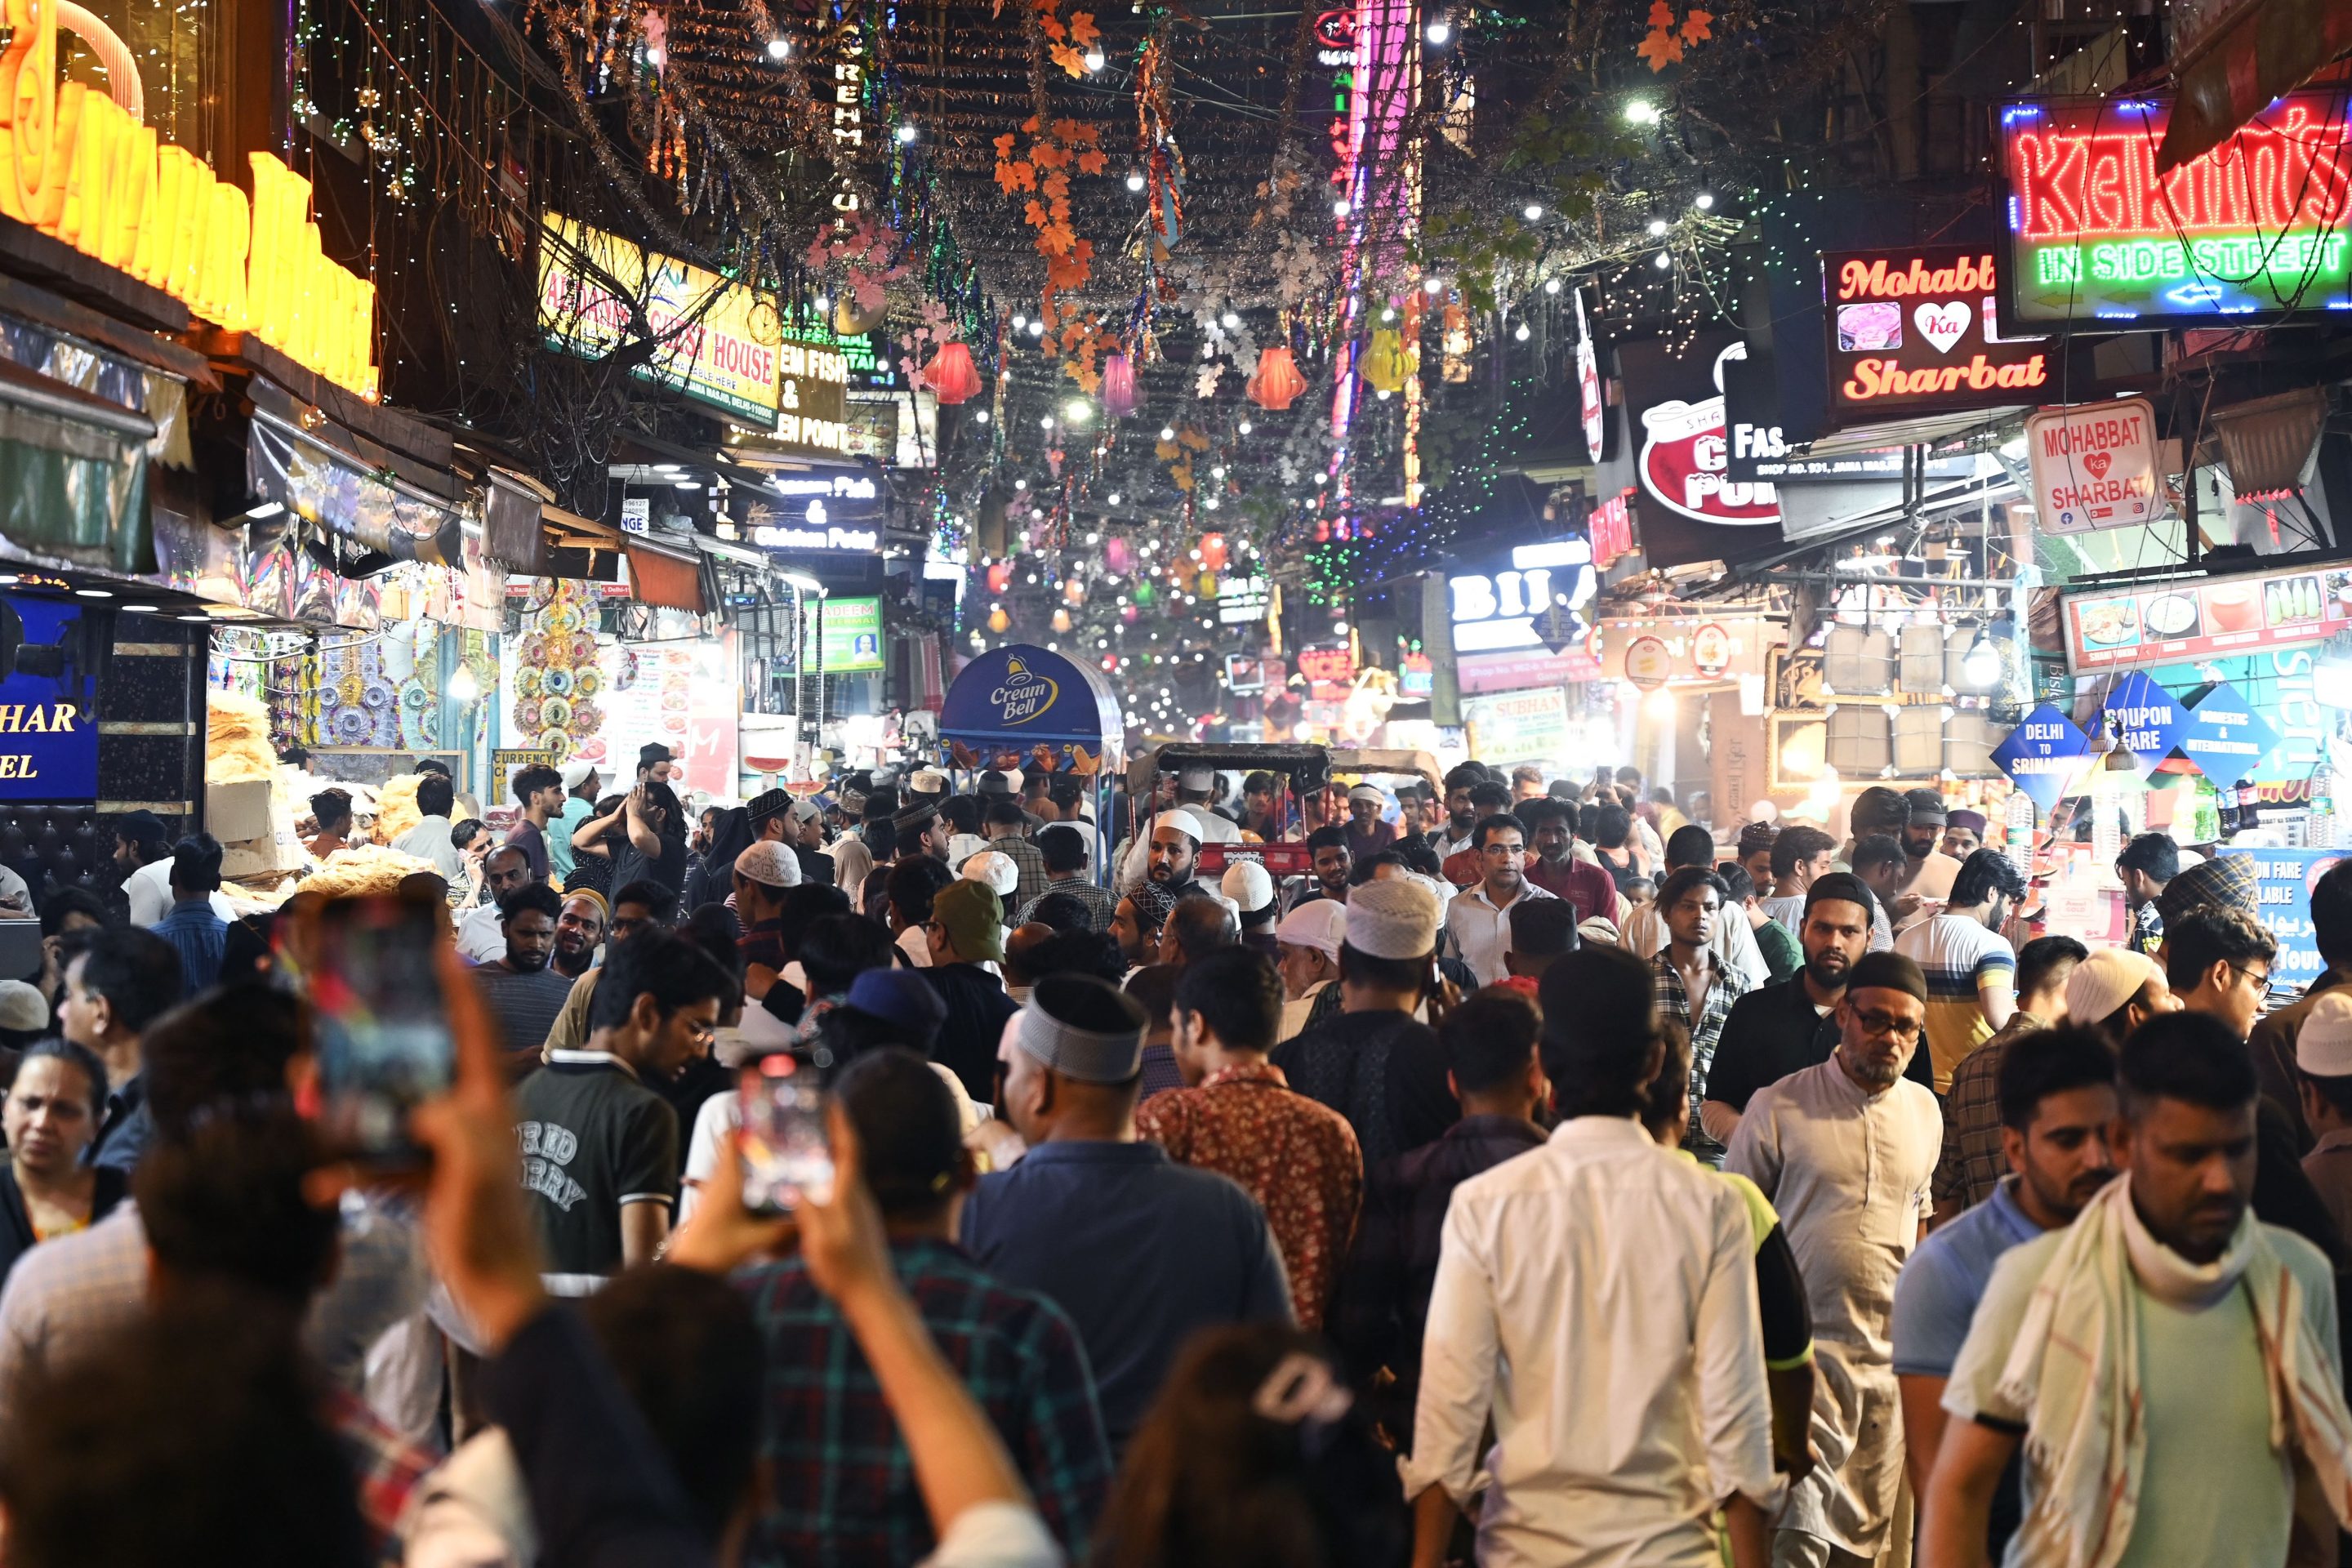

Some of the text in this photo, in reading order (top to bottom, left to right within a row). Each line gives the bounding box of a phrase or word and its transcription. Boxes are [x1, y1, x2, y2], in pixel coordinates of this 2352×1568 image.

[2038, 234, 2346, 284] IN SIDE STREET
[1925, 315, 1959, 334] Ka
[713, 332, 773, 385] HOUSE
[808, 349, 848, 383] FISH
[1843, 354, 2047, 399] Sharbat
[782, 380, 799, 408] &
[803, 417, 848, 449] POINT
[2043, 416, 2140, 457] MOHABBAT
[1757, 464, 1787, 476] SHOP
[2090, 458, 2107, 470] ka
[2051, 476, 2146, 510] SHARBAT
[806, 499, 826, 523] &
[991, 684, 1046, 705] Cream
[1004, 697, 1036, 719] Bell
[1495, 695, 1561, 718] SUBHAN
[0, 704, 76, 733] HAR
[2025, 724, 2065, 740] DELHI
[2219, 726, 2228, 738] &
[494, 754, 553, 764] CURRENCY
[2038, 743, 2051, 755] TO
[0, 755, 38, 778] EL
[2273, 862, 2302, 880] FARE
